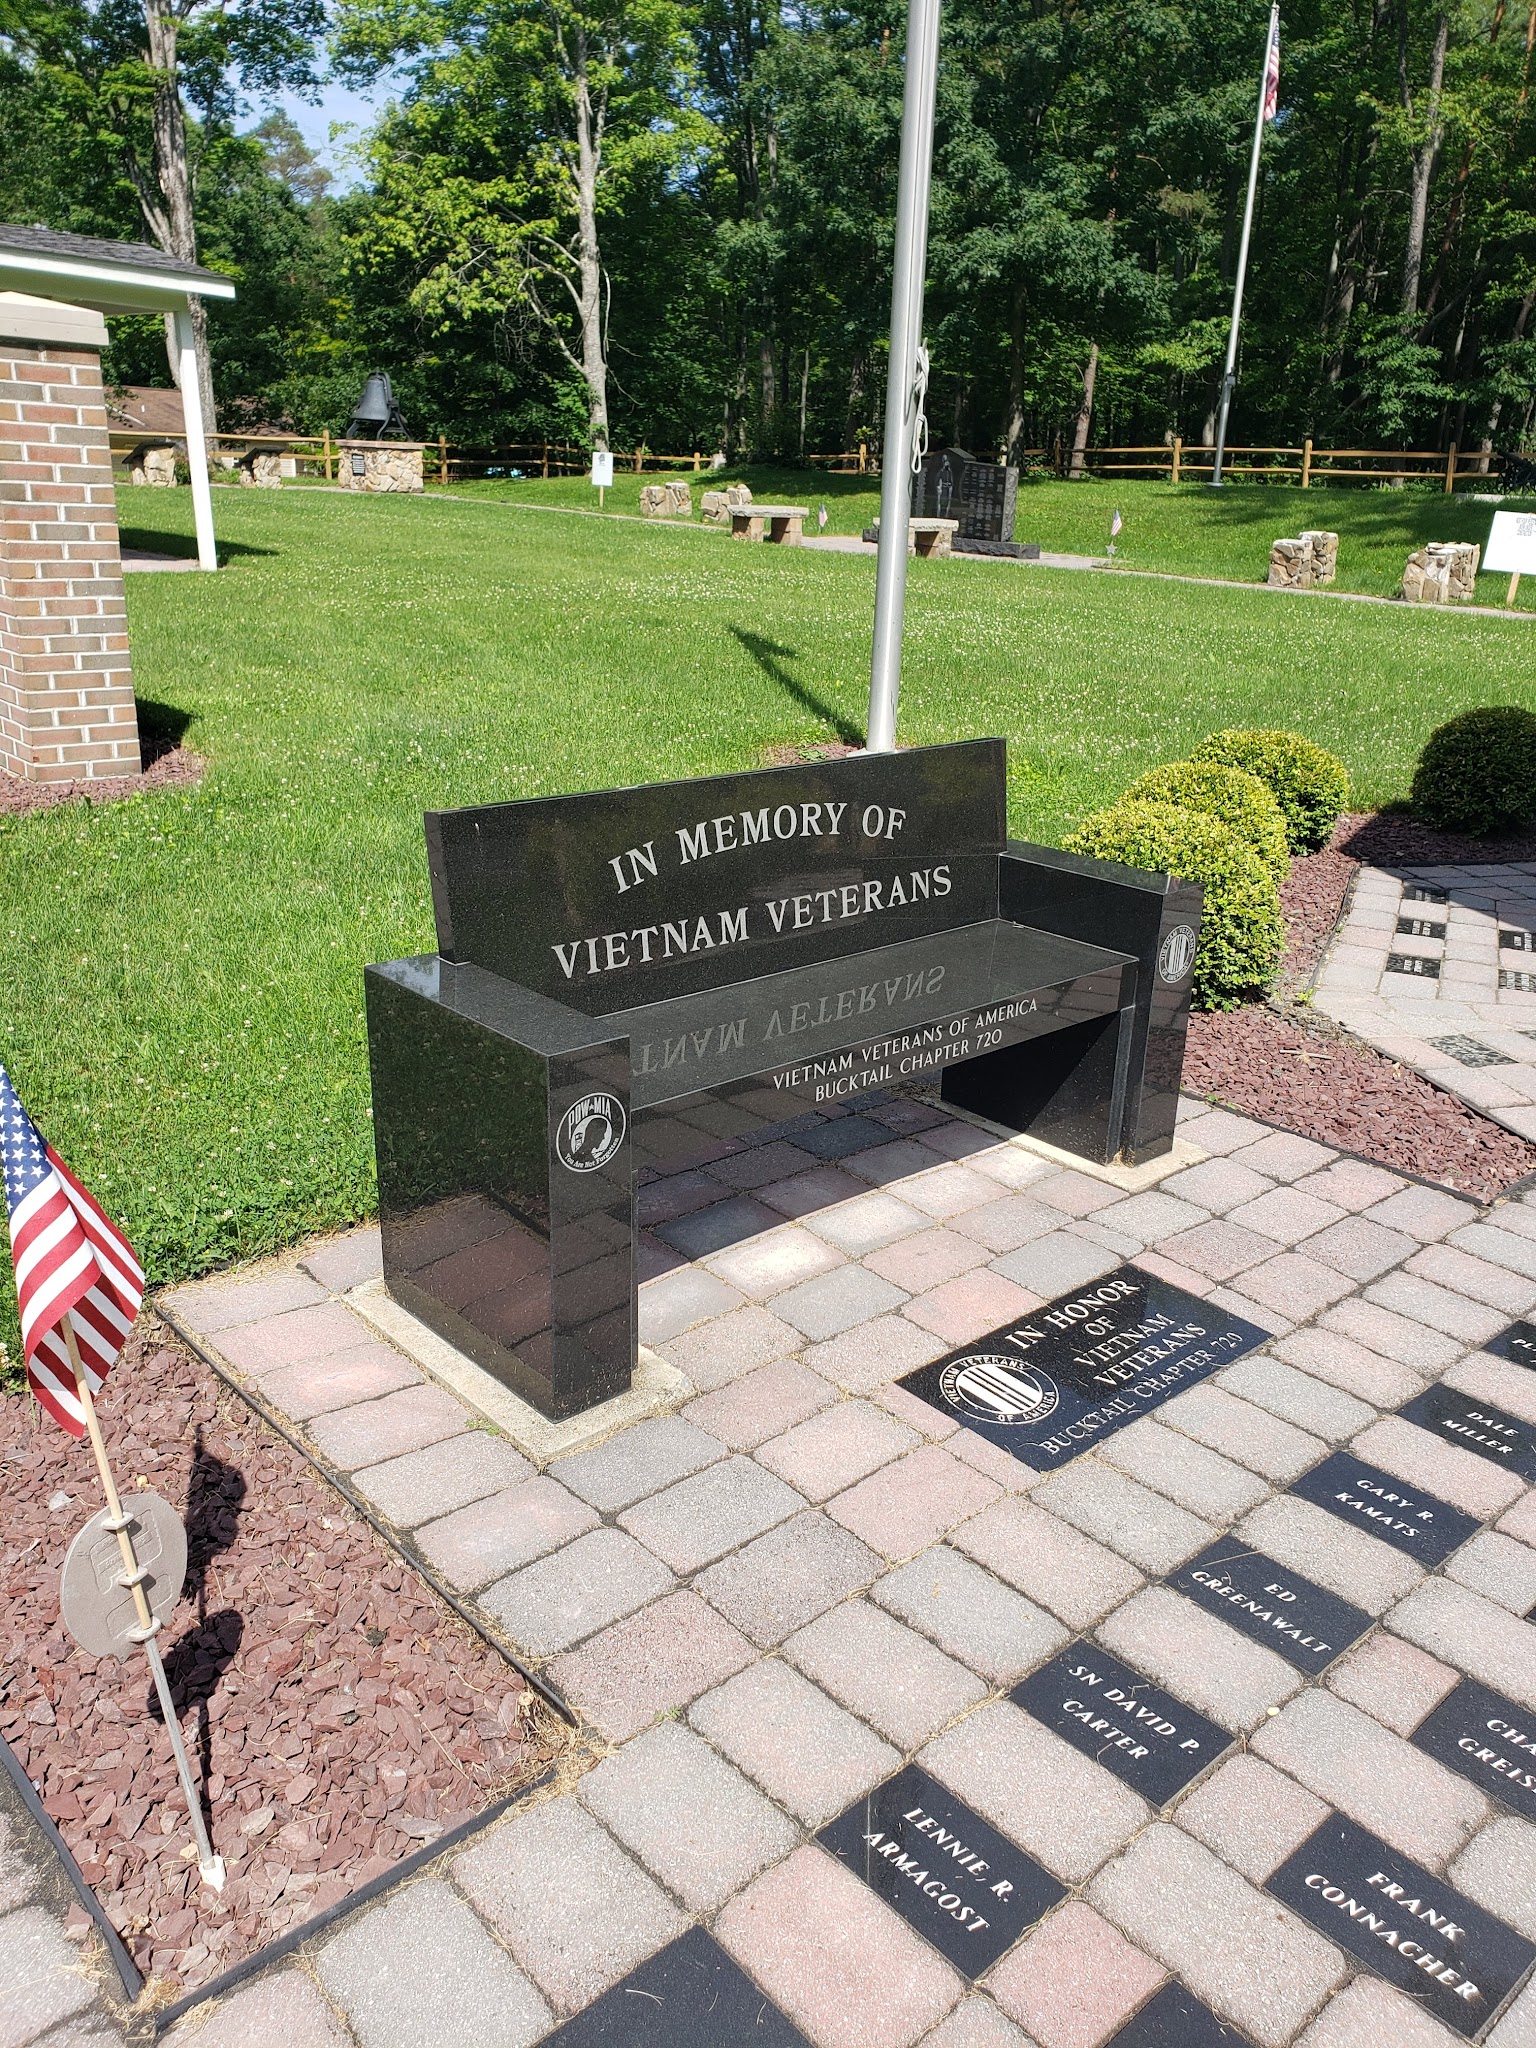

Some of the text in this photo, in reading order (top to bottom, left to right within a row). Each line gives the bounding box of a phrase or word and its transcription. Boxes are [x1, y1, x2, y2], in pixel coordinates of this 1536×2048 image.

[608, 802, 906, 894] IN MEMORY OF
[551, 865, 952, 979] VIETNAM VETERANS
[773, 998, 1038, 1090] VIETNAM VETERANS OF AMERICA
[815, 1028, 1002, 1102] BUCKTAIL CHAPTER 720
[564, 1137, 619, 1169] You Are Not Forgotten
[1004, 1279, 1140, 1350] IN HONOR
[1073, 1312, 1176, 1368] VIETNAM
[1084, 1315, 1117, 1337] OF
[943, 1356, 1026, 1403] VIETNAM VETERANS
[1094, 1323, 1207, 1387] VETERANS
[996, 1391, 1056, 1422] OF AMERICA
[1039, 1331, 1243, 1456] BUCKTAIL CHAPTER 720
[1466, 1411, 1520, 1437] DALE
[1441, 1419, 1514, 1455] MILLER
[1335, 1492, 1420, 1538] KAMATS
[1355, 1479, 1435, 1524] GARY R.
[1191, 1570, 1332, 1654] GREENAWALT
[1263, 1583, 1297, 1603] ED
[1062, 1699, 1150, 1761] CARTER
[1069, 1665, 1199, 1755] SN DAVID P.
[1457, 1737, 1536, 1794] GREIS
[862, 1830, 991, 1934] ARMAGOST
[902, 1807, 1014, 1903] LENNIE R.
[1304, 1874, 1486, 2001] CONNACHER
[1365, 1871, 1467, 1942] FRANK
